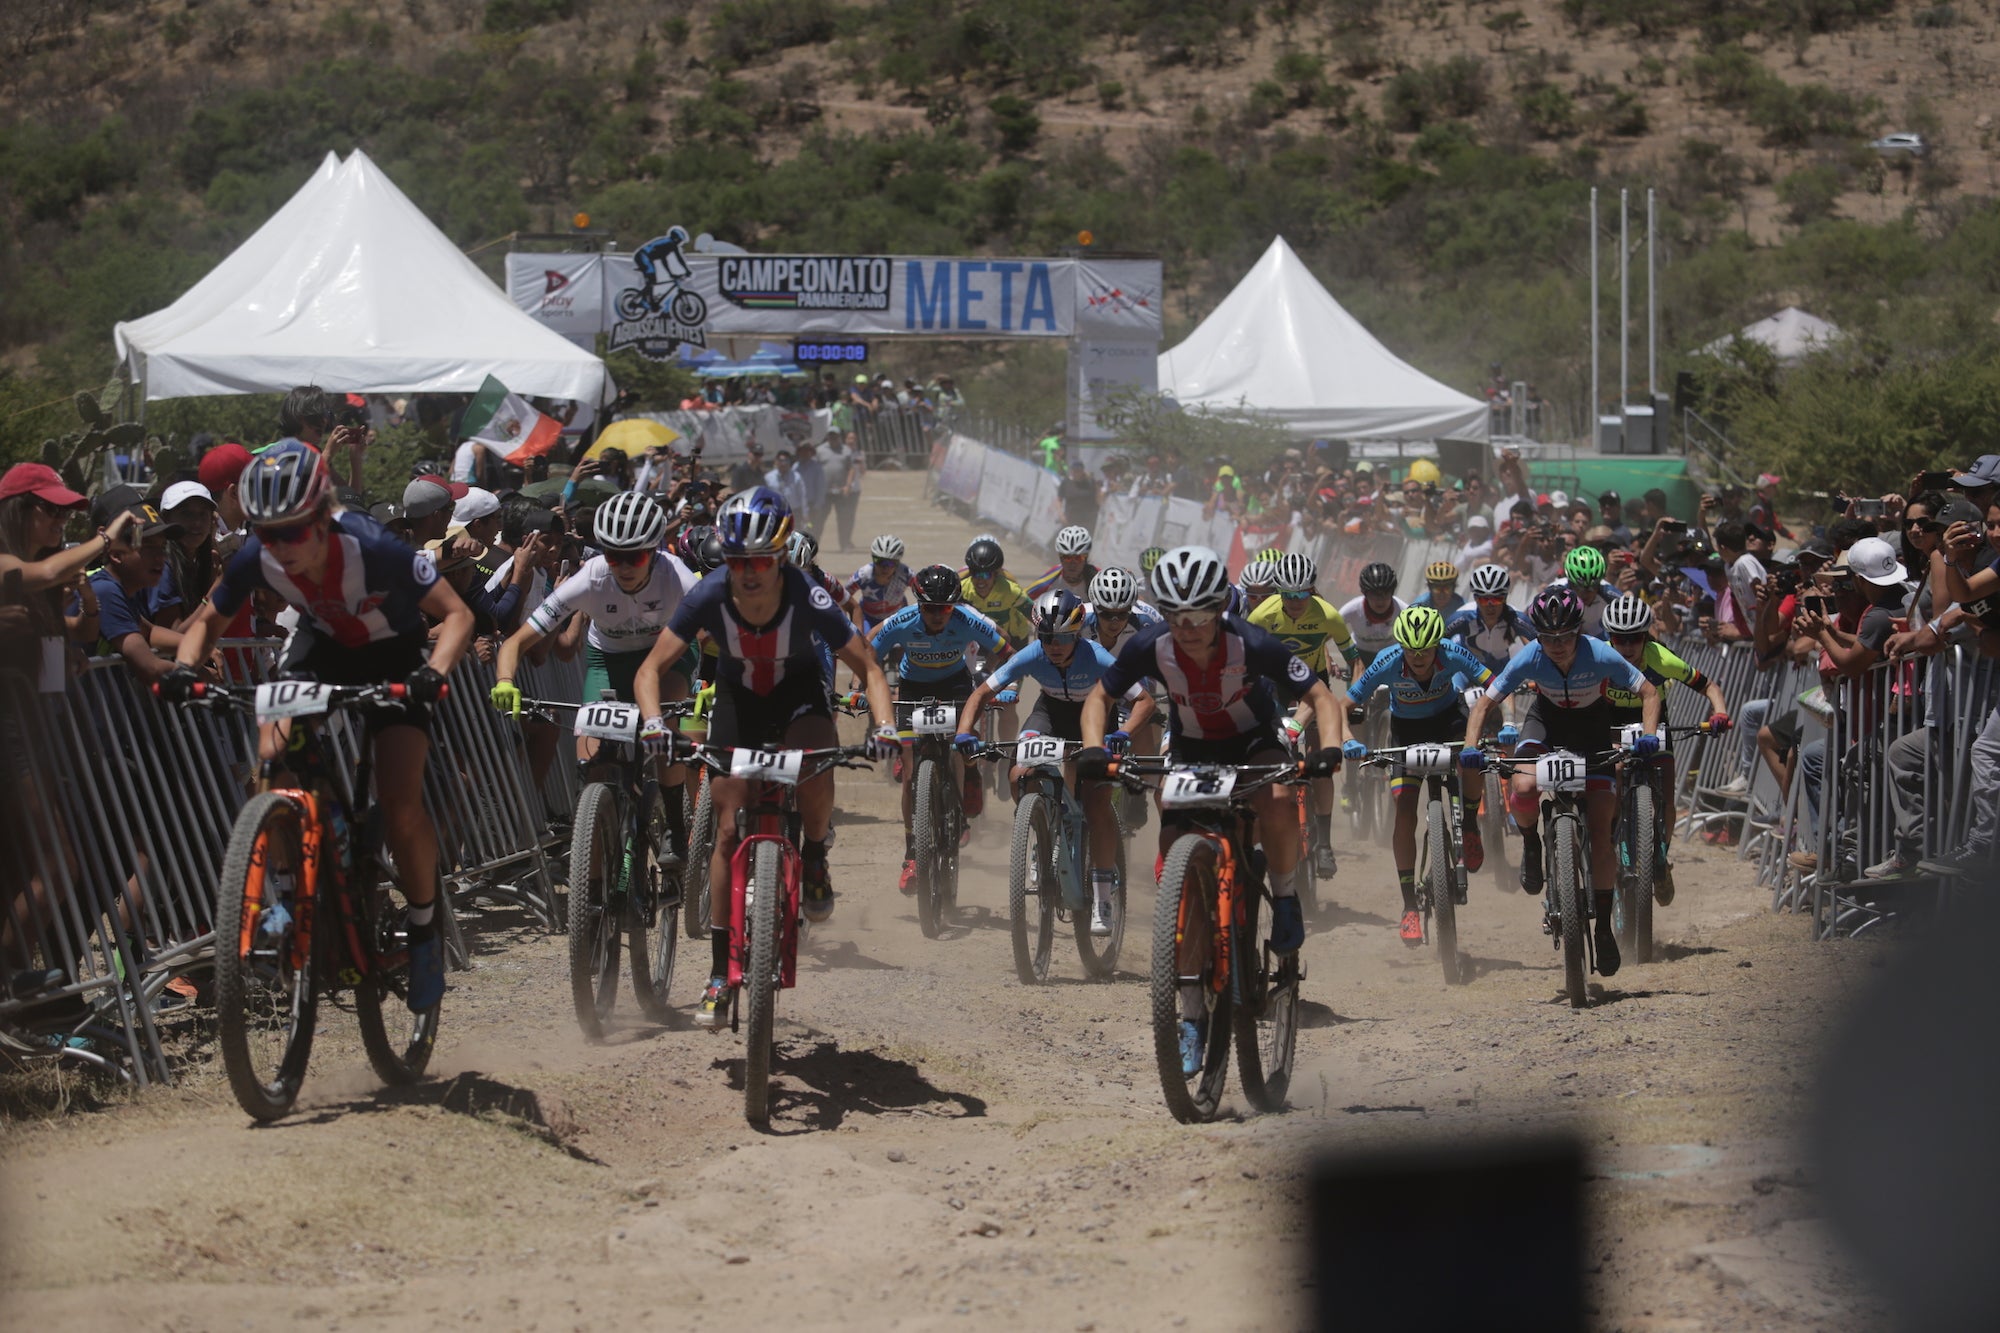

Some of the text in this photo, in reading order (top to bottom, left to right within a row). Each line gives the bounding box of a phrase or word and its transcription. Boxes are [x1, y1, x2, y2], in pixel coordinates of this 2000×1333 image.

[722, 258, 888, 293] CAMPEONATO
[797, 293, 887, 309] PANAMERICANO
[905, 261, 1057, 331] META
[798, 345, 865, 360] 00:00:08
[876, 610, 919, 642] COLOMBIA
[1442, 643, 1480, 669] OLOMBIA
[1360, 648, 1400, 686] COLOMBIA
[268, 684, 322, 708] 104
[1473, 690, 1484, 699] 11
[1607, 688, 1637, 700] CUAD
[586, 708, 629, 729] 105
[1631, 731, 1643, 741] 11
[1024, 742, 1057, 759] 102
[1416, 749, 1440, 767] 117
[1547, 760, 1575, 781] 110
